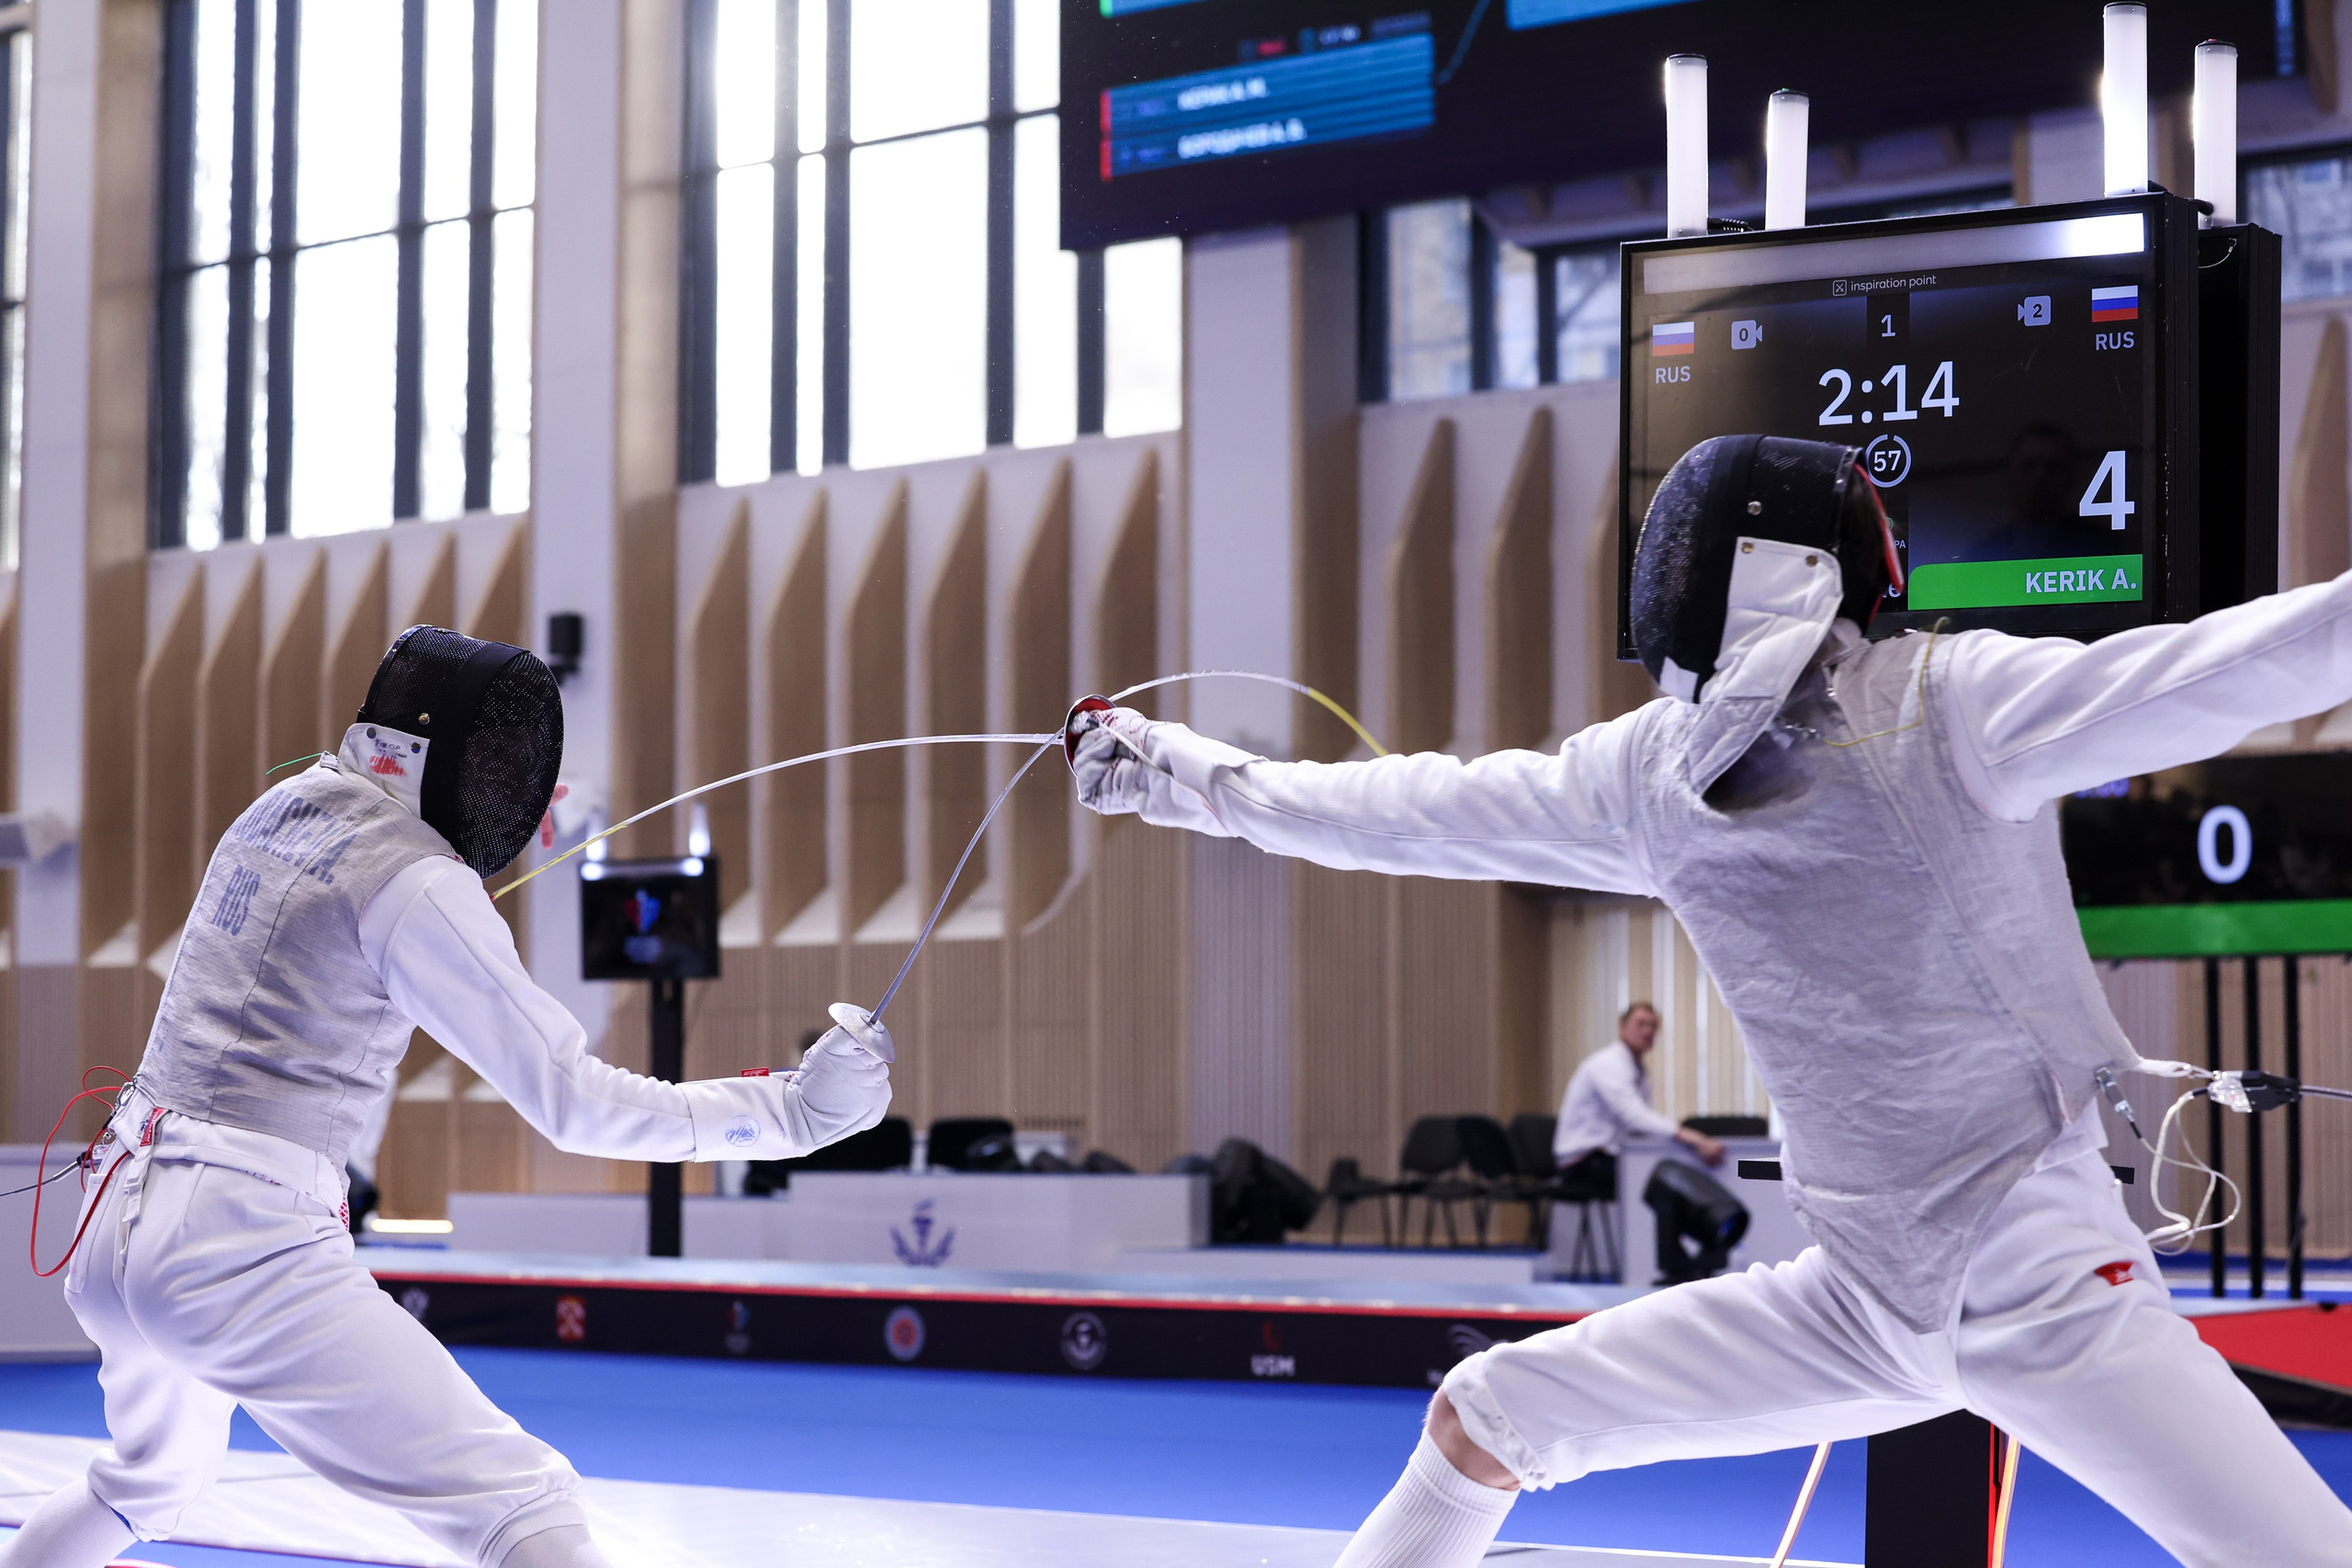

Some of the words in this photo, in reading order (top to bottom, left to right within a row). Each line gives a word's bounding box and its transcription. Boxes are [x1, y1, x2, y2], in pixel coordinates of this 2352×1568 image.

[1850, 277, 1906, 292] inspiration
[1909, 275, 1937, 288] point
[2032, 303, 2043, 319] 2
[1738, 327, 1749, 343] 0
[1881, 314, 1896, 337] 1
[2096, 331, 2135, 351] RUS
[1656, 365, 1691, 384] RUS
[1818, 360, 1960, 426] 2:14
[1873, 449, 1902, 472] 57
[2079, 450, 2135, 531] 4
[2026, 569, 2105, 593] KERIK
[2110, 568, 2138, 590] A.
[2197, 804, 2252, 885] 0
[210, 863, 261, 936] RUS
